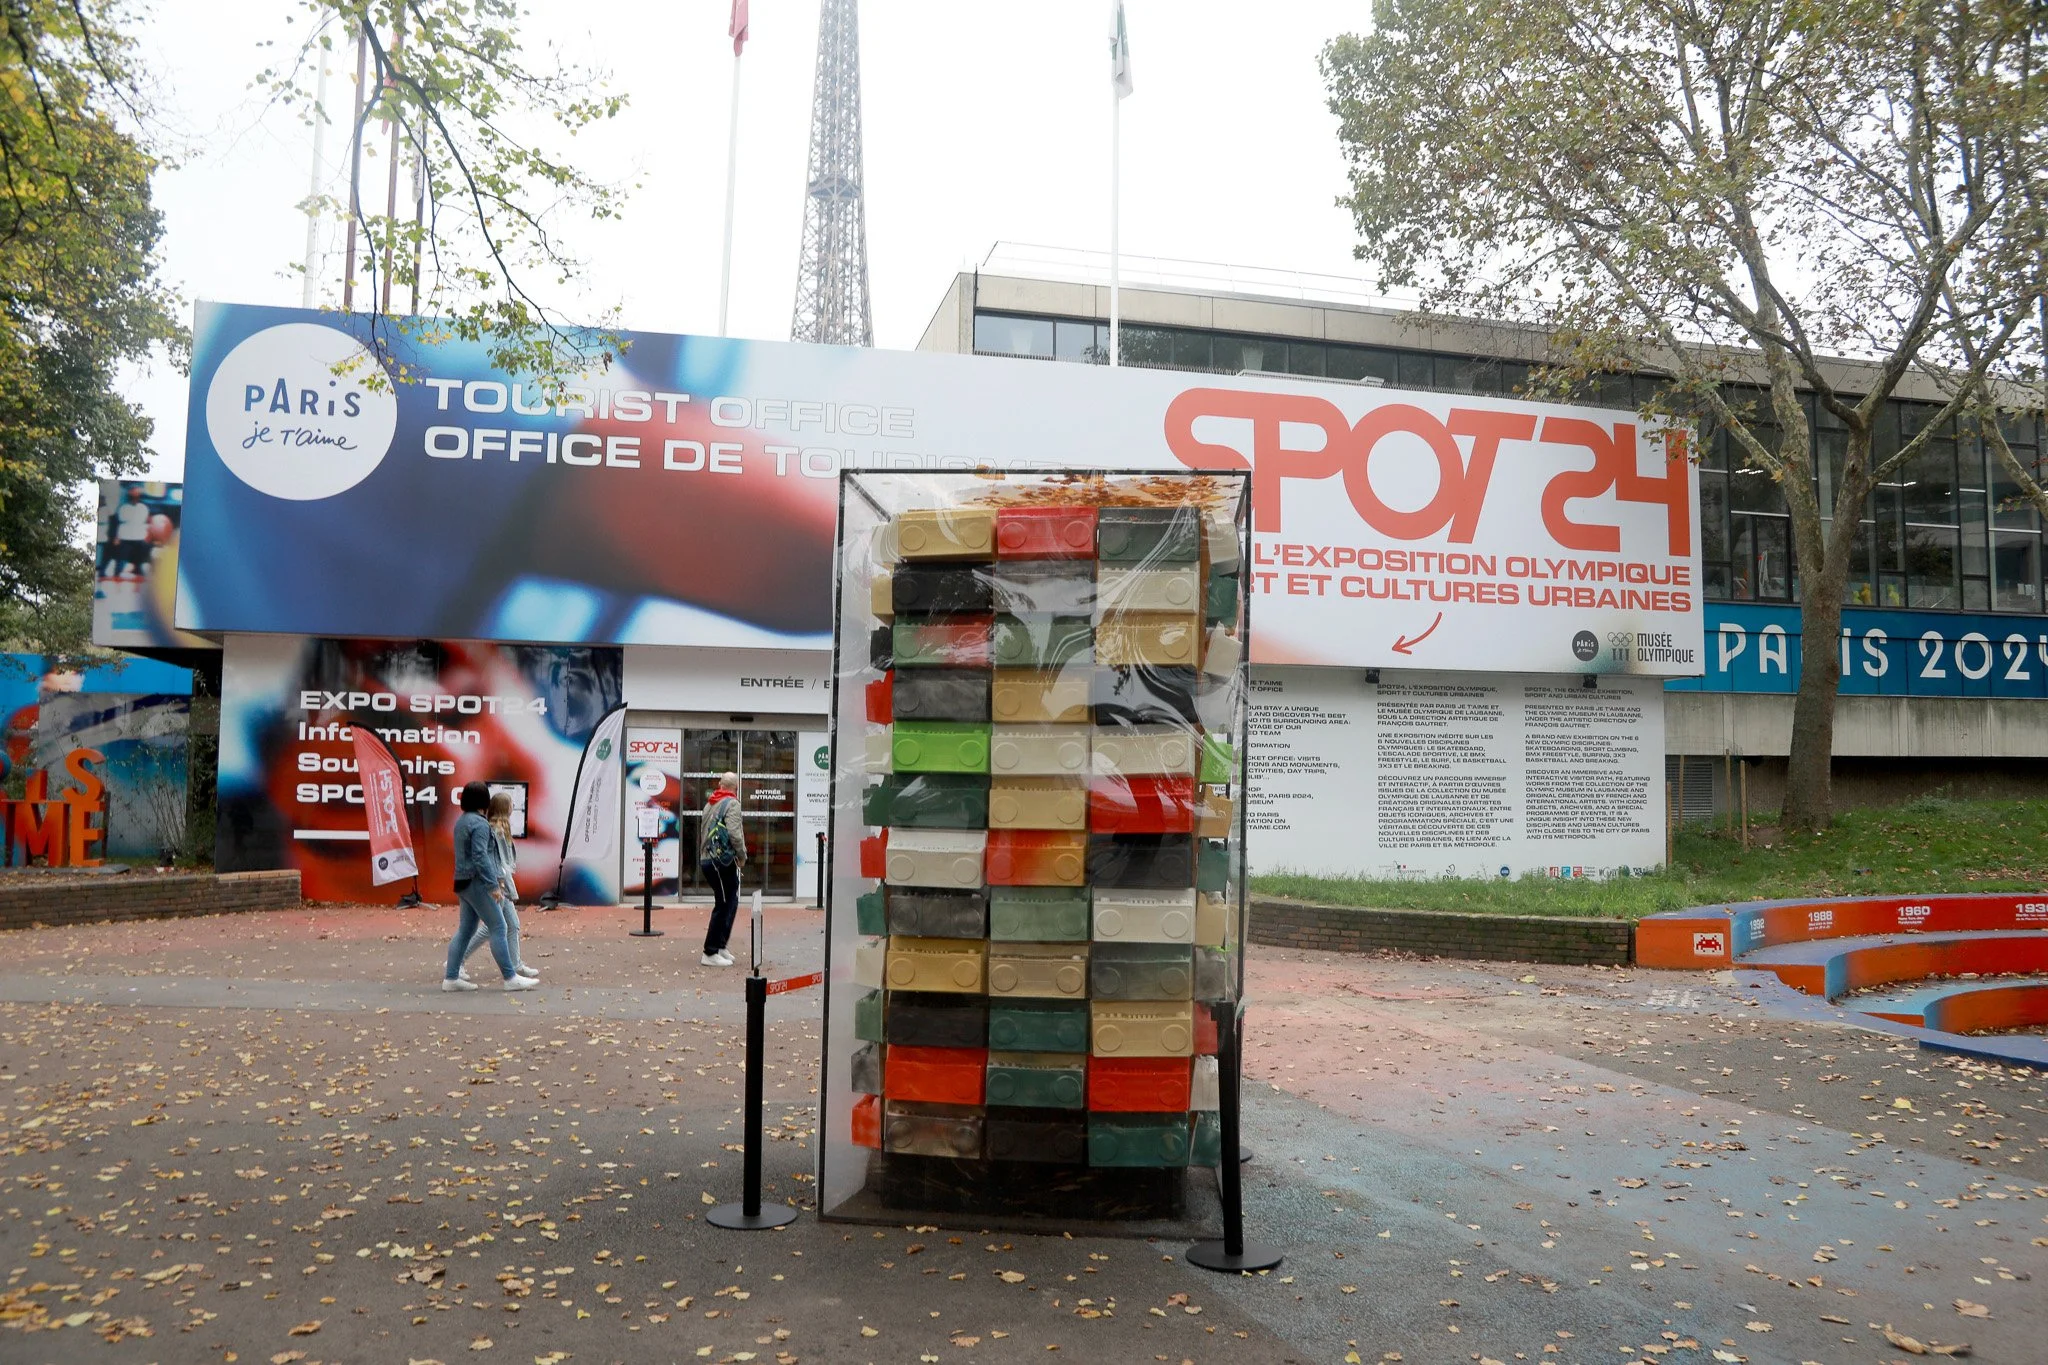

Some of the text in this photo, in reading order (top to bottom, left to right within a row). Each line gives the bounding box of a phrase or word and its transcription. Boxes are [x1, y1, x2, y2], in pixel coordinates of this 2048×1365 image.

[244, 378, 361, 417] PARIS
[425, 378, 915, 439] TOURIST OFFICE
[242, 419, 273, 447] je
[424, 425, 641, 469] OFFICE
[663, 438, 743, 475] DE
[1254, 543, 1691, 586] L'EXPOSITION OLYMPIQUE
[1287, 573, 1332, 596] ET
[1340, 575, 1519, 605] CULTURES
[1528, 583, 1691, 613] URBAINES
[1576, 640, 1595, 648] PARIS
[1637, 632, 1672, 648] MUSÉE
[1719, 622, 1889, 678] PAIS
[1637, 648, 1694, 664] OLYMPIQUE
[740, 676, 804, 689] ENTRÉE
[300, 691, 548, 715] EXPO SPOT24
[298, 722, 481, 744] Infomation
[297, 753, 456, 775] Sounirs
[1808, 910, 1833, 922] 1988
[1897, 906, 1931, 916] 1960
[2015, 903, 2048, 913] 193
